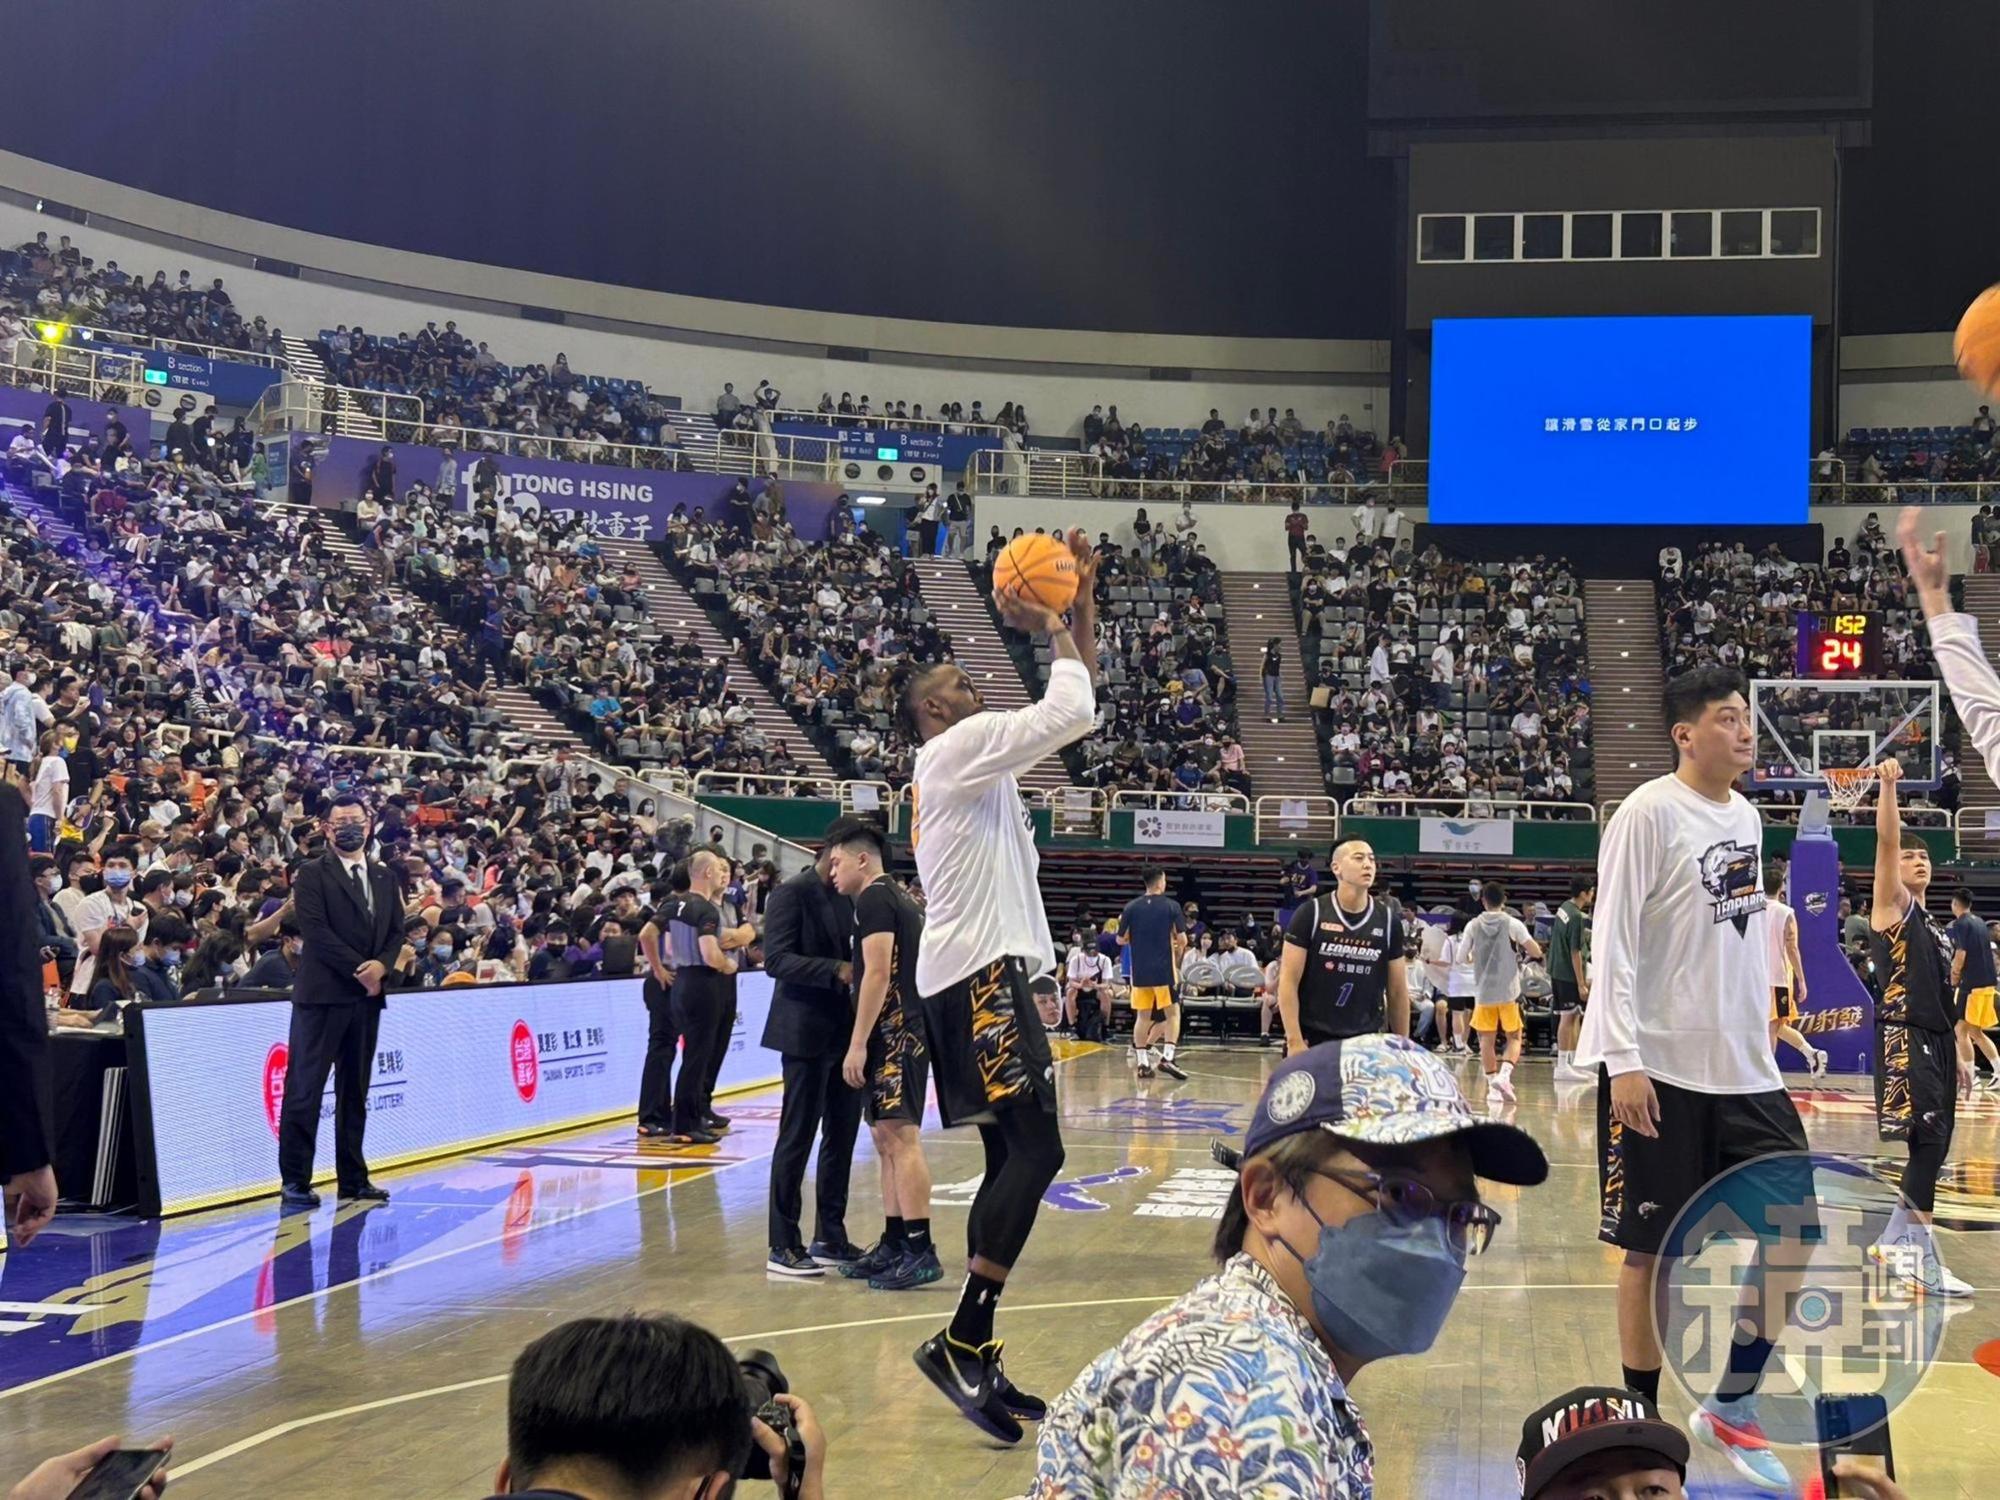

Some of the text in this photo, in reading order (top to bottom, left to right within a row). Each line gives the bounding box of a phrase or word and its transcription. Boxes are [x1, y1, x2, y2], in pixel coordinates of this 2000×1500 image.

[167, 356, 176, 369] B
[1544, 417, 1698, 432] 讓滑雪從家門口起步
[900, 434, 908, 446] B
[936, 436, 944, 448] 2
[512, 473, 654, 503] TONG HSING
[1822, 638, 1862, 671] 24
[676, 901, 687, 917] 7
[1319, 942, 1382, 961] LEOPARDS
[1335, 982, 1354, 1007] 1
[374, 1093, 404, 1111] LOTTERY
[1541, 1397, 1646, 1448] MIAMI
